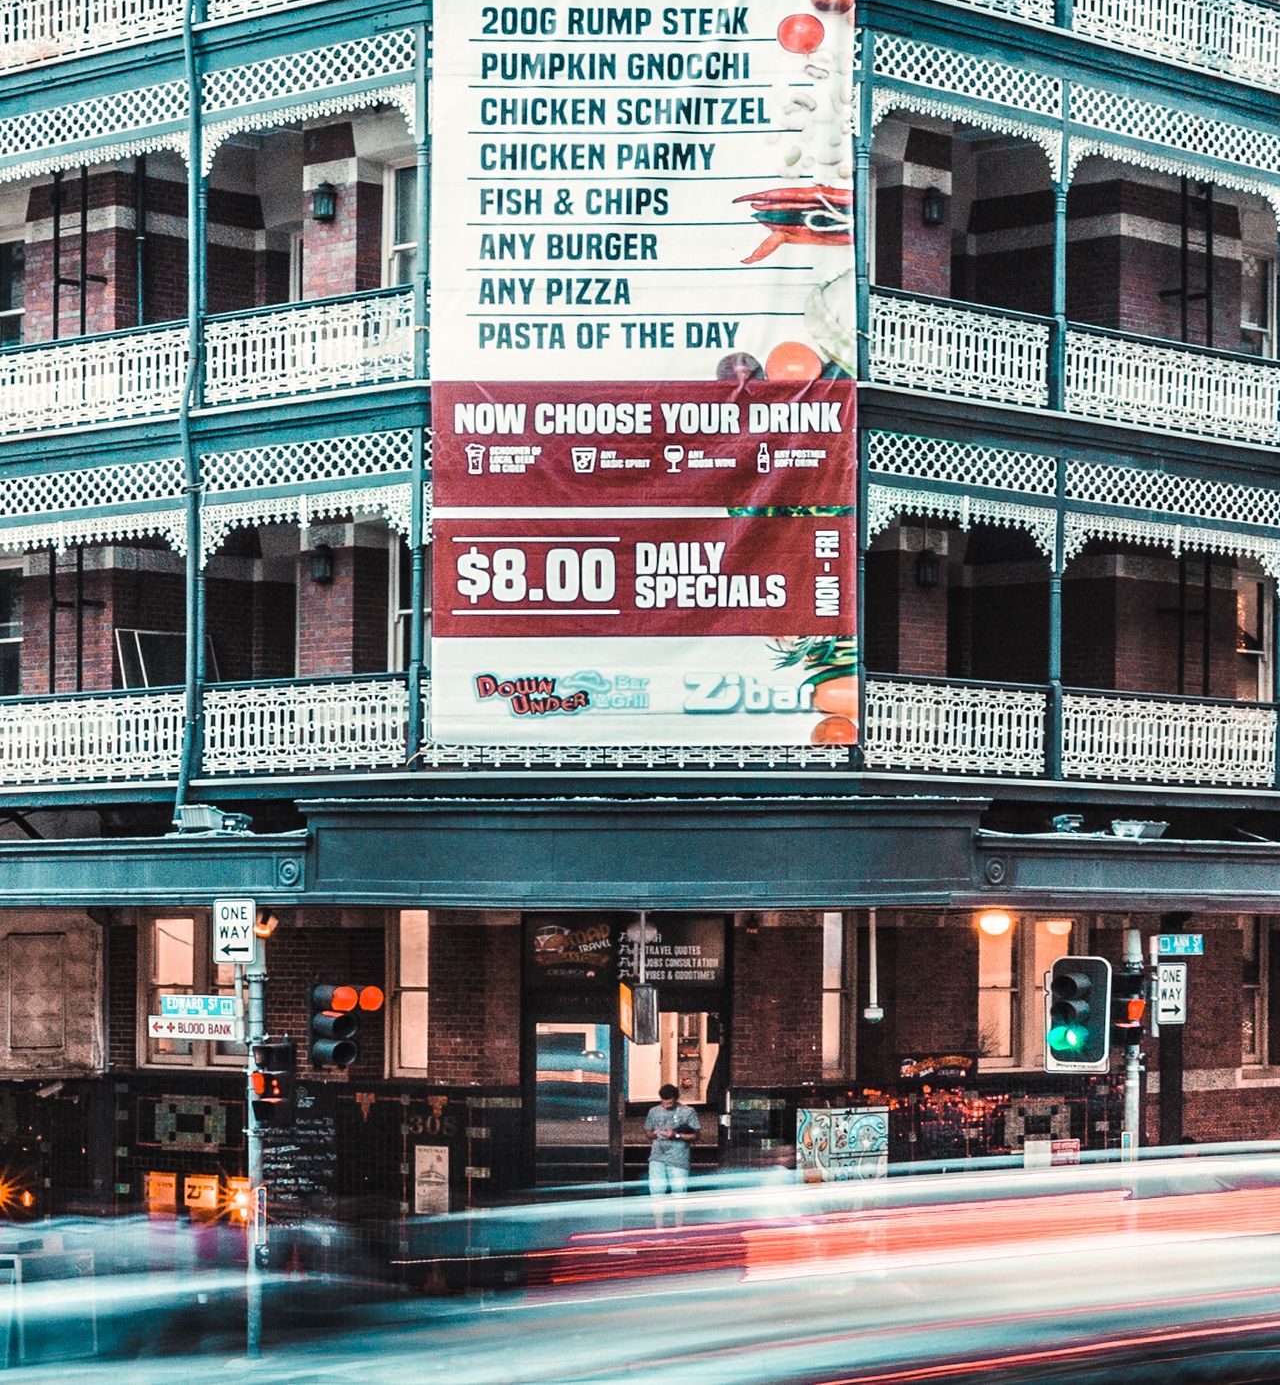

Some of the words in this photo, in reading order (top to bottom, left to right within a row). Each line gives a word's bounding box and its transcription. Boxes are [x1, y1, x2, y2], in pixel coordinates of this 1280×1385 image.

[481, 7, 557, 36] 200G
[567, 7, 652, 36] RUMP
[662, 6, 749, 36] STEAK
[481, 52, 617, 81] PUMPKIN
[627, 51, 750, 81] GNOCCHI
[480, 97, 607, 127] CHICKEN
[617, 96, 771, 126] SCHNITZEL
[480, 143, 606, 171] CHICKEN
[616, 143, 716, 171] PARMY
[479, 188, 542, 216] FISH
[553, 188, 574, 216] &
[584, 187, 670, 216] CHIPS
[478, 233, 536, 261] ANY
[546, 233, 658, 261] BURGER
[478, 278, 536, 305] ANY
[545, 278, 631, 306] PIZZA
[478, 322, 566, 350] PASTA
[576, 322, 611, 350] OF
[621, 322, 675, 349] THE
[685, 321, 740, 349] DAY
[453, 402, 527, 435] NOW
[534, 402, 652, 435] CHOOSE
[660, 402, 740, 434] YOUR
[747, 402, 843, 434] DRINK
[815, 530, 839, 558] FRI
[635, 541, 726, 576] DAILY
[456, 547, 616, 604] $8.00
[634, 575, 787, 609] SPECIALS
[815, 576, 839, 617] MON
[615, 674, 650, 691] Bar
[684, 672, 816, 714] Zibar
[611, 694, 650, 709] Grill
[221, 906, 247, 920] ONE
[219, 925, 249, 939] WAY
[578, 939, 612, 953] TRAVEL
[1173, 936, 1189, 947] ANN
[646, 945, 672, 955] TRAVEL
[674, 945, 701, 956] QUOTES
[664, 958, 719, 968] CONSULTATION
[645, 970, 665, 980] VIBES
[1162, 969, 1181, 982] ONE
[166, 997, 205, 1010] EDWARD
[1161, 988, 1181, 1001] WAY
[178, 1022, 205, 1034] BLOOD
[208, 1023, 231, 1034] BANK
